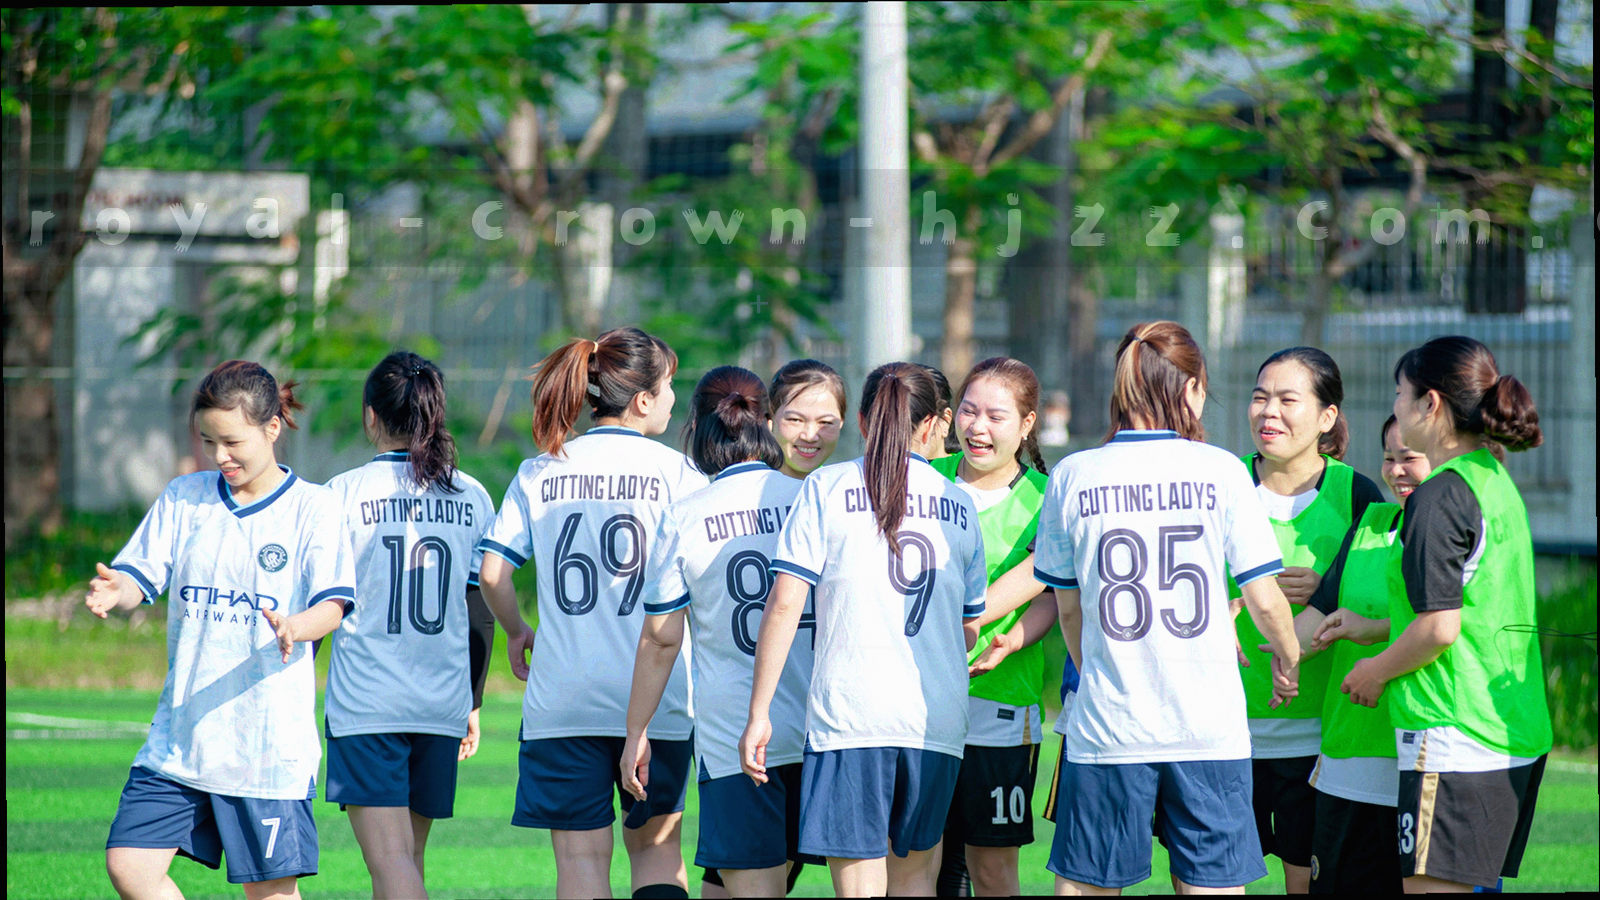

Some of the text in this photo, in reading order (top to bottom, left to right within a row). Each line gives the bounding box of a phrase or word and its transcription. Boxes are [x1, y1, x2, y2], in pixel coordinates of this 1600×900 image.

[541, 474, 660, 503] CUTTING LADYS
[1078, 481, 1216, 518] CUTTING LADYS
[360, 498, 474, 527] CUTTING LADYS
[704, 507, 775, 543] CUTTING
[918, 494, 967, 531] LADYS
[553, 512, 647, 616] 69
[179, 585, 279, 612] ETIHAD
[382, 535, 452, 635] 10
[888, 530, 936, 637] 9
[1098, 525, 1210, 642] 85
[183, 608, 257, 626] AIRWAYS
[990, 785, 1025, 825] 10
[260, 817, 281, 859] 7
[1397, 812, 1415, 855] 3
